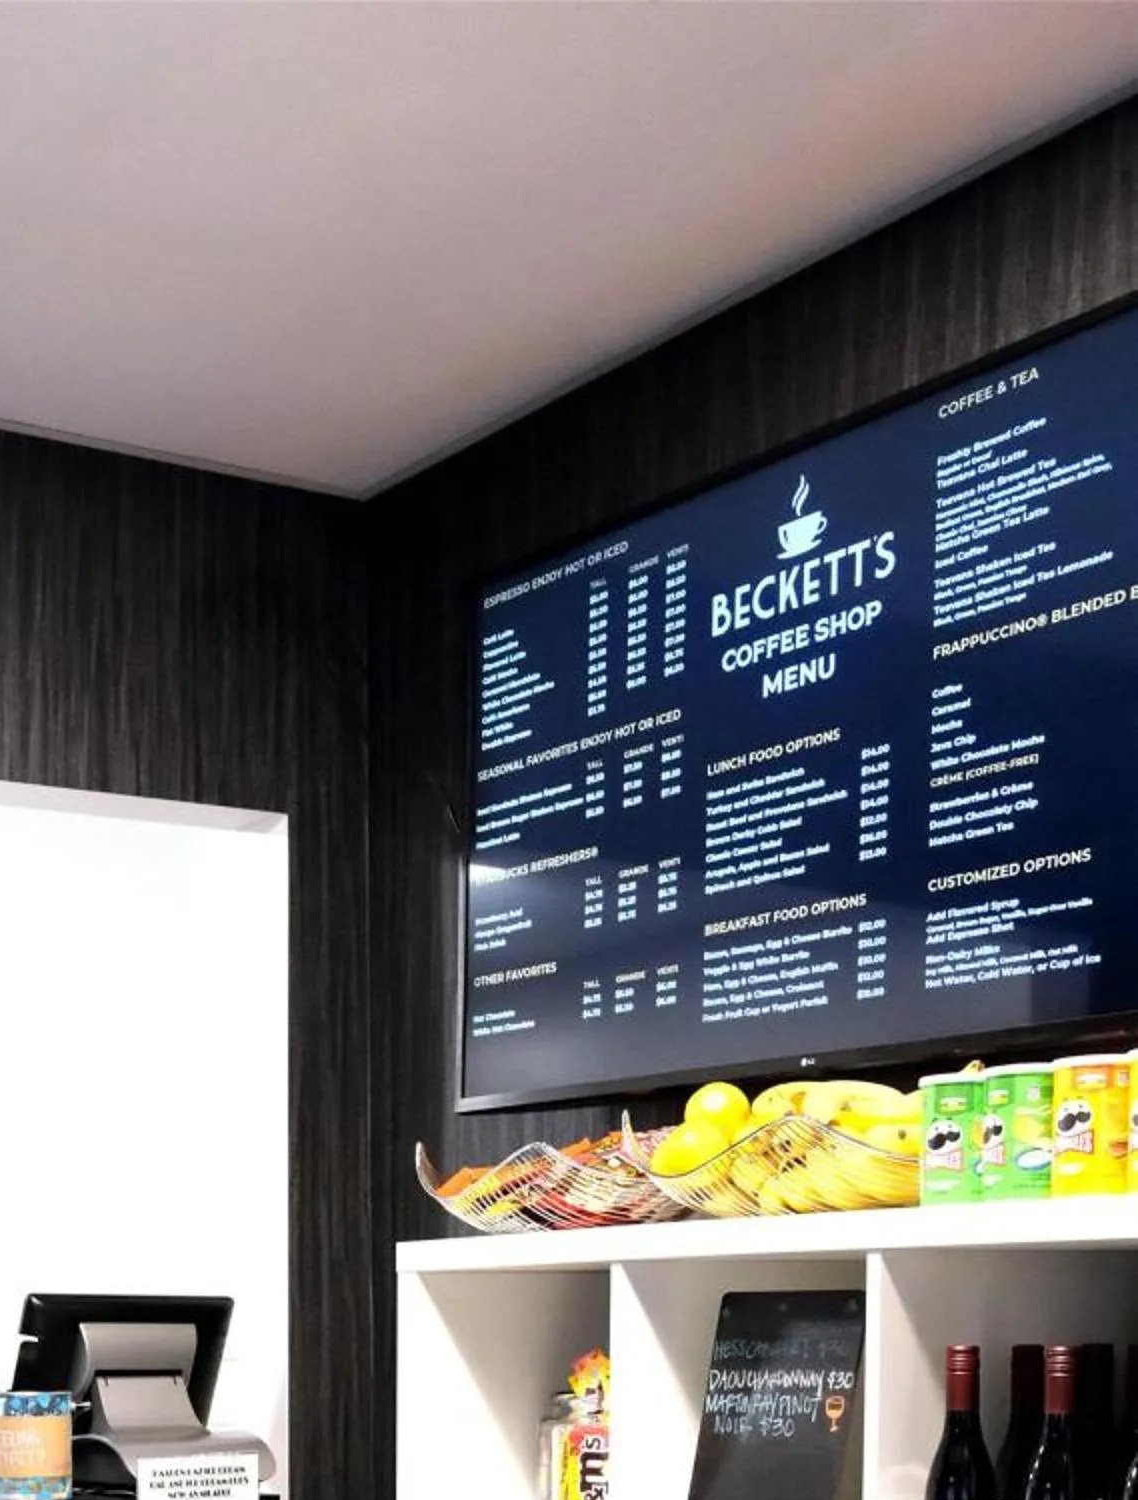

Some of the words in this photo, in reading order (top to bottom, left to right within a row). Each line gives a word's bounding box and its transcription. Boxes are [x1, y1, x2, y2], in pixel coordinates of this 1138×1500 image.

[938, 385, 994, 419] COFFEE
[997, 381, 1006, 395] &
[1010, 367, 1039, 388] TEA
[1013, 417, 1047, 436] Coffee
[1002, 449, 1028, 465] Latte
[978, 479, 995, 493] Hot
[1038, 458, 1057, 469] Tea
[1004, 516, 1020, 528] Tea
[1023, 506, 1050, 522] Latte
[957, 545, 989, 561] Coffee
[1038, 542, 1056, 554] Tea
[484, 583, 530, 608] ESPRESSO
[565, 560, 585, 576] HOT
[587, 554, 602, 567] OR
[604, 541, 628, 561] ICED
[712, 531, 896, 638] BECKETT'S
[1037, 569, 1055, 581] Tea
[1051, 590, 1126, 623] BLENDED
[721, 623, 810, 672] COFFEE
[814, 600, 882, 642] SHOP
[763, 653, 836, 699] MENU
[932, 684, 963, 699] Coffee
[478, 759, 525, 782] SEASONAL
[526, 742, 578, 767] FAVORITES
[614, 721, 635, 738] HOT
[638, 717, 654, 730] OR
[655, 708, 681, 726] ICED
[707, 756, 746, 776] LUNCH
[748, 745, 783, 765] FOOD
[786, 727, 841, 753] OPTIONS
[954, 734, 976, 746] Chip
[1014, 798, 1038, 811] Chip
[965, 825, 994, 839] Green
[996, 822, 1014, 832] Tea
[928, 864, 1020, 892] CUSTOMIZED
[1024, 848, 1092, 873] OPTIONS
[705, 912, 771, 937] BREAKFAST
[773, 906, 808, 923] FOOD
[811, 893, 867, 915] OPTIONS
[474, 972, 504, 987] OTHER
[506, 962, 557, 982] FAVORITES
[926, 980, 942, 988] Hot
[1050, 960, 1070, 970] Cup
[1072, 956, 1084, 966] of
[827, 1369, 854, 1390] $30
[760, 1415, 795, 1437] $30
